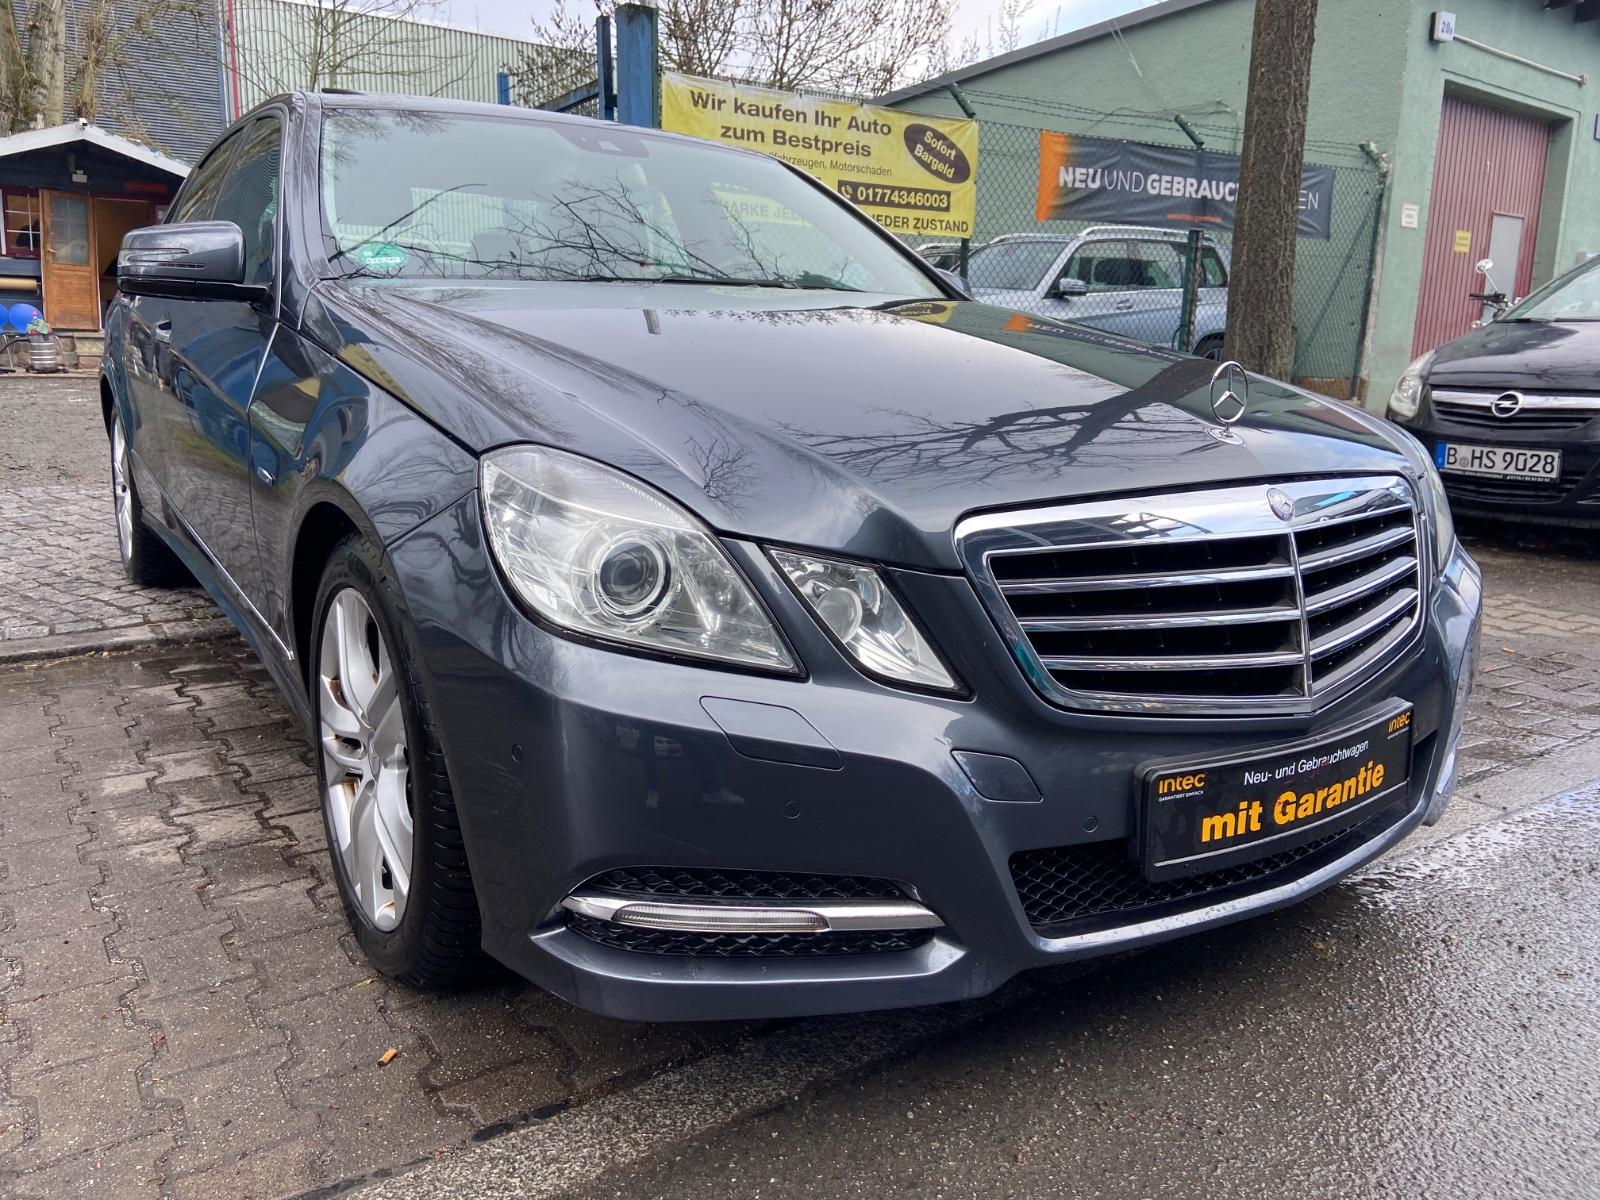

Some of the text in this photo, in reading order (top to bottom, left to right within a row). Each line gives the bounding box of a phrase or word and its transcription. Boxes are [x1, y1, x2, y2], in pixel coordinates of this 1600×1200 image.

[690, 90, 891, 135] Wir kaufen Ihr Auto
[721, 125, 871, 157] zum Bestpreis
[924, 130, 957, 160] Sofort
[830, 161, 892, 176] Motorschaden
[914, 144, 956, 179] Bargeld
[1059, 166, 1101, 189] NEU
[1105, 169, 1145, 192] UND
[857, 187, 948, 208] 01774346003
[872, 214, 969, 233] EDER ZUSTAND
[1447, 447, 1458, 465] B
[1470, 449, 1497, 469] HS
[1502, 452, 1556, 474] 9028
[1388, 711, 1410, 733] intec
[1244, 740, 1369, 786] Neu- und Gebrauchtwagen
[1159, 774, 1206, 794] intec
[1201, 761, 1385, 843] mit Garantie
